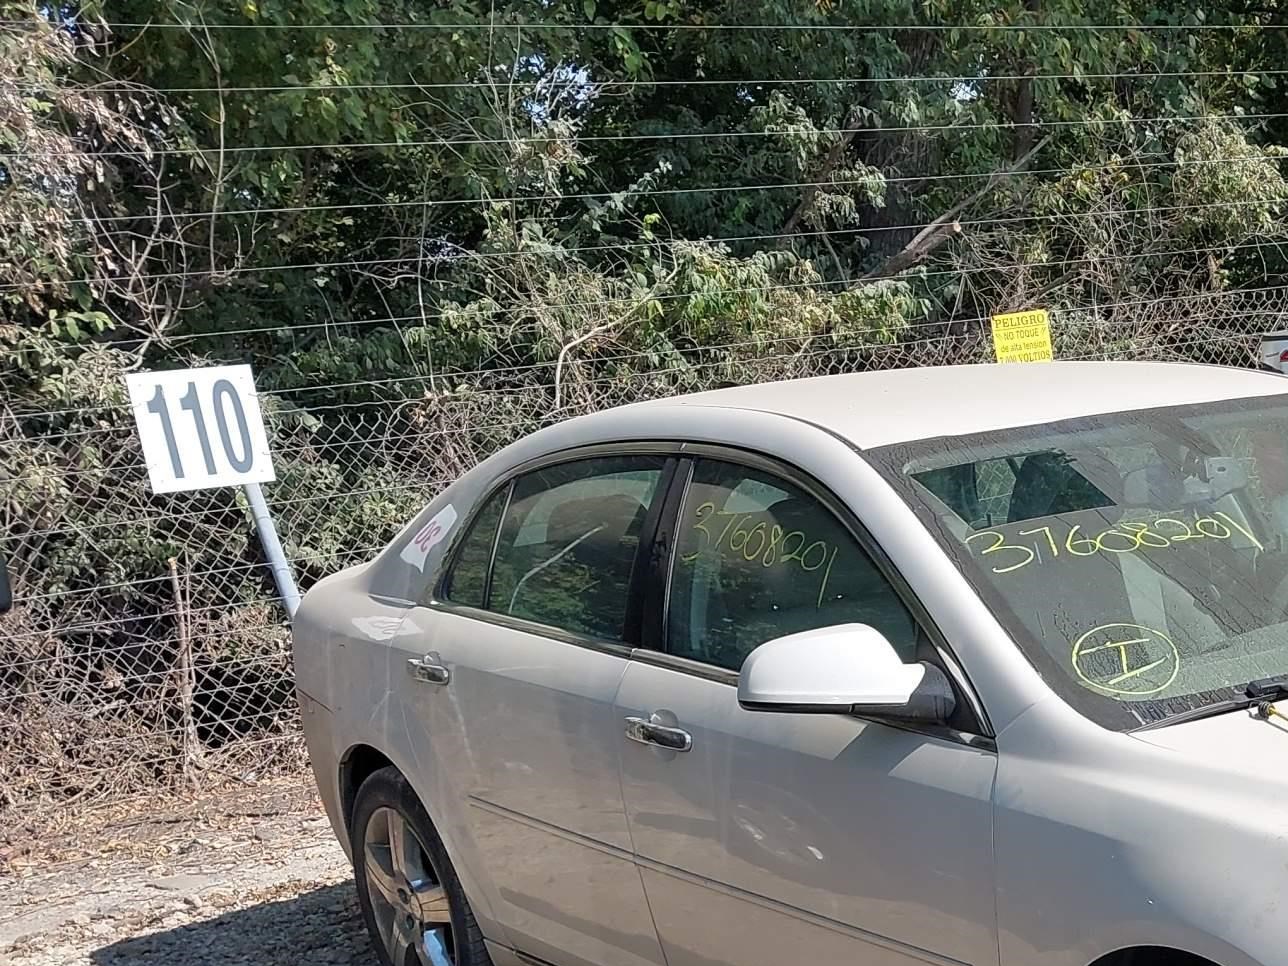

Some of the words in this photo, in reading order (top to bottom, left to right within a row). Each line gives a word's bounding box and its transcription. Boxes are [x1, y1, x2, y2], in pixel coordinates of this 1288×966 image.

[995, 314, 1045, 328] PELIGRO
[1003, 330, 1014, 341] NO
[1016, 327, 1040, 339] TOQUE
[1000, 344, 1009, 353] de
[1018, 350, 1050, 363] VOLTIOS
[147, 379, 253, 479] 110
[964, 511, 1265, 573] 37608201
